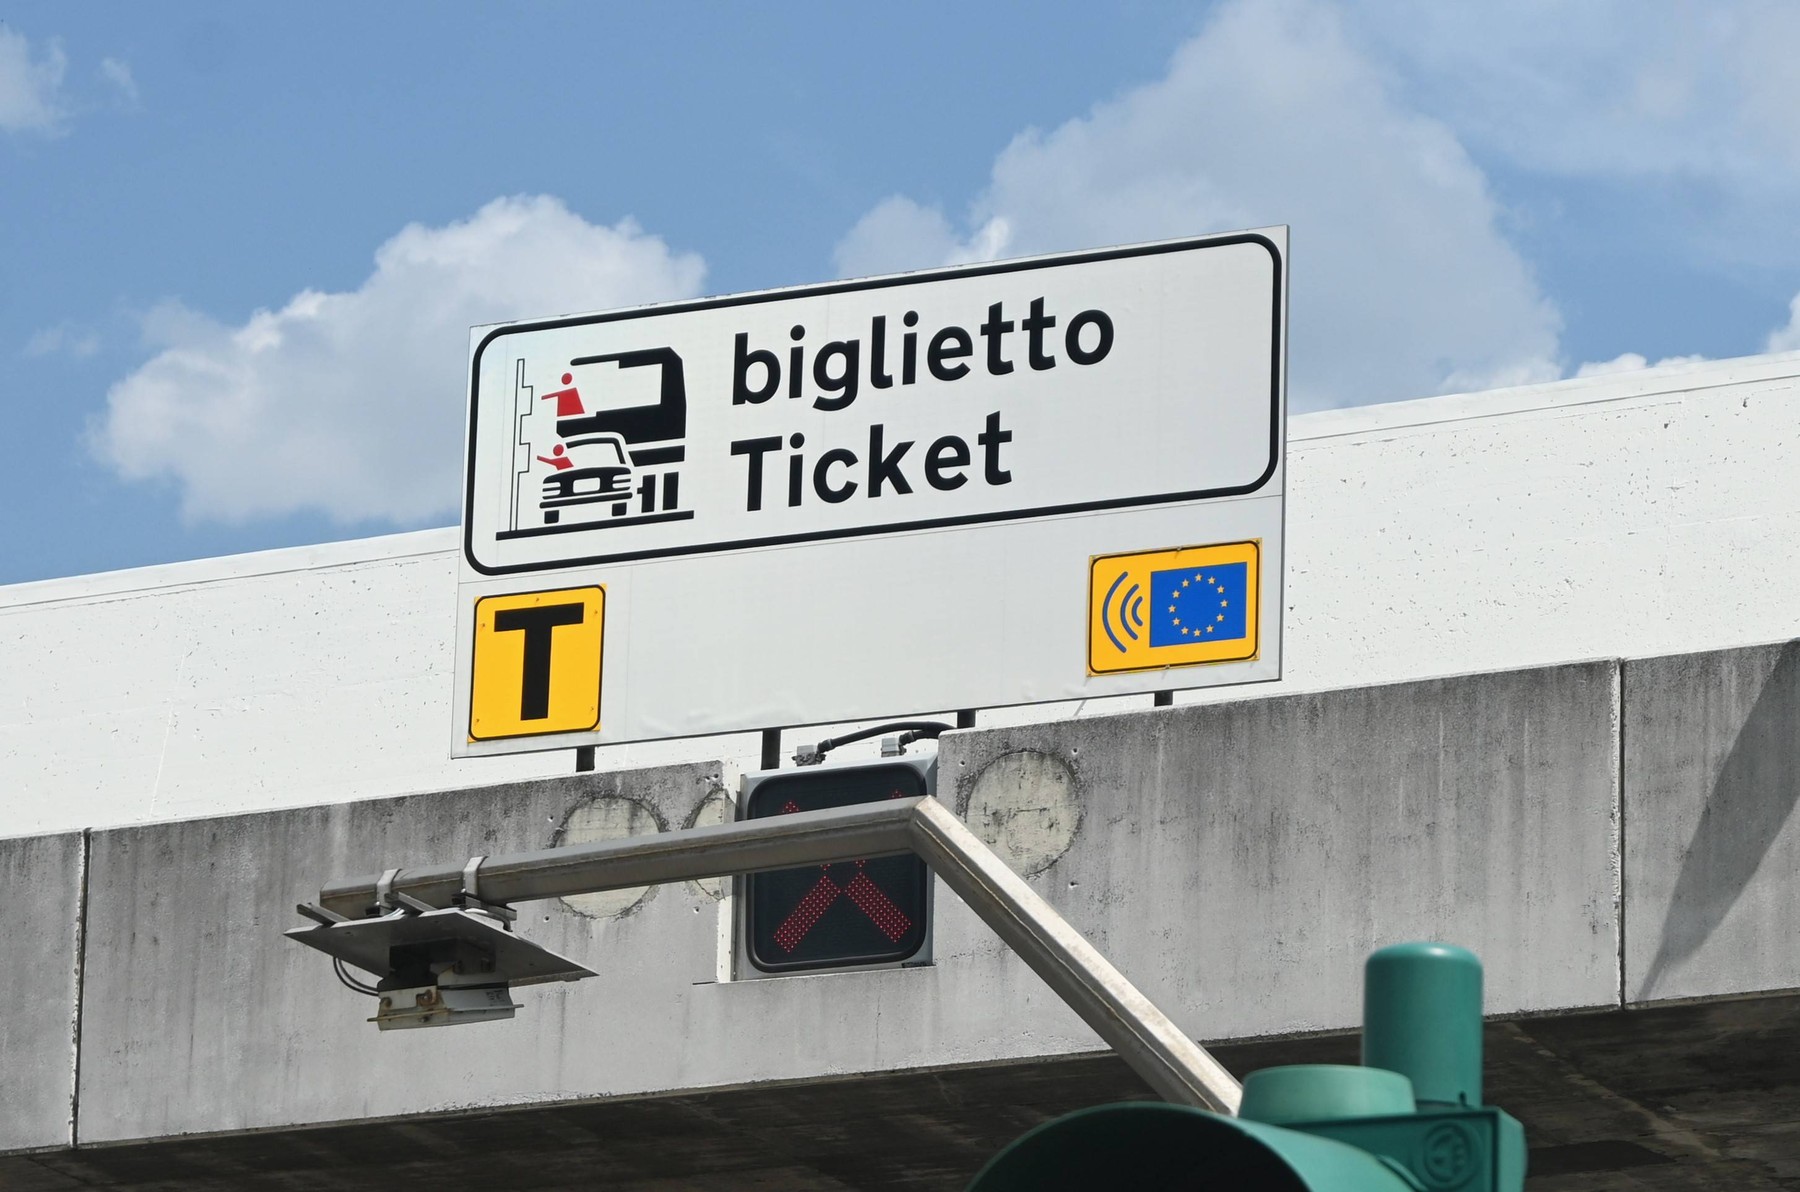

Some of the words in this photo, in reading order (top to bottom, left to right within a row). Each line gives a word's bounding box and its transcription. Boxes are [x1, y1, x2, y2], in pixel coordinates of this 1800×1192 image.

[732, 297, 1114, 411] biglietto
[731, 411, 1013, 512] Ticket
[494, 603, 584, 720] T
